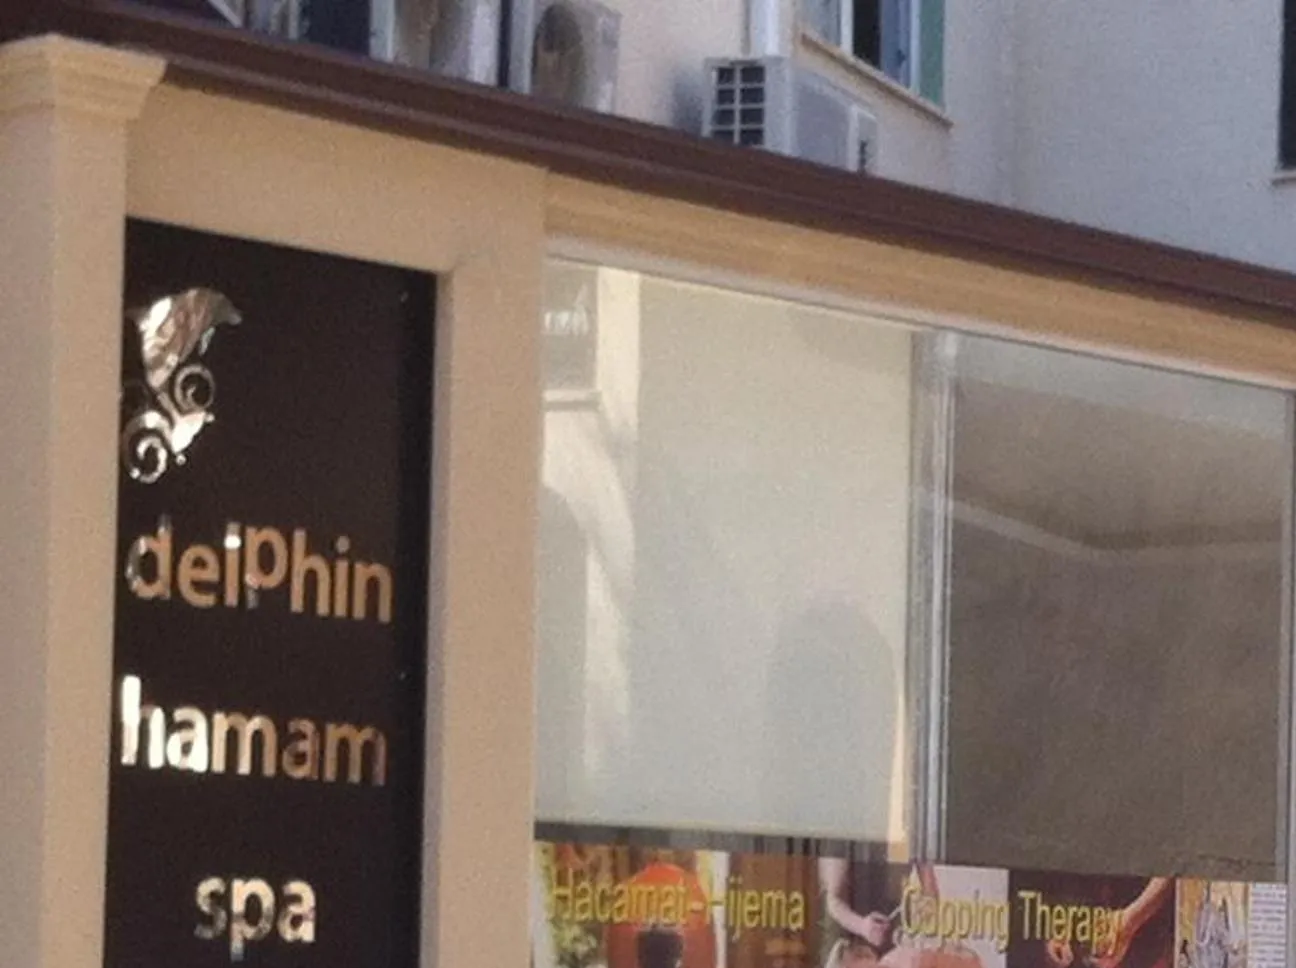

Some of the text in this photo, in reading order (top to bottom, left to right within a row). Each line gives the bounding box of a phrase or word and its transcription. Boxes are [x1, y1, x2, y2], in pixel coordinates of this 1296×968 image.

[126, 514, 393, 624] delphin
[120, 674, 386, 787] hamam
[194, 875, 316, 962] spa
[903, 884, 1125, 956] Cupping Therapy
